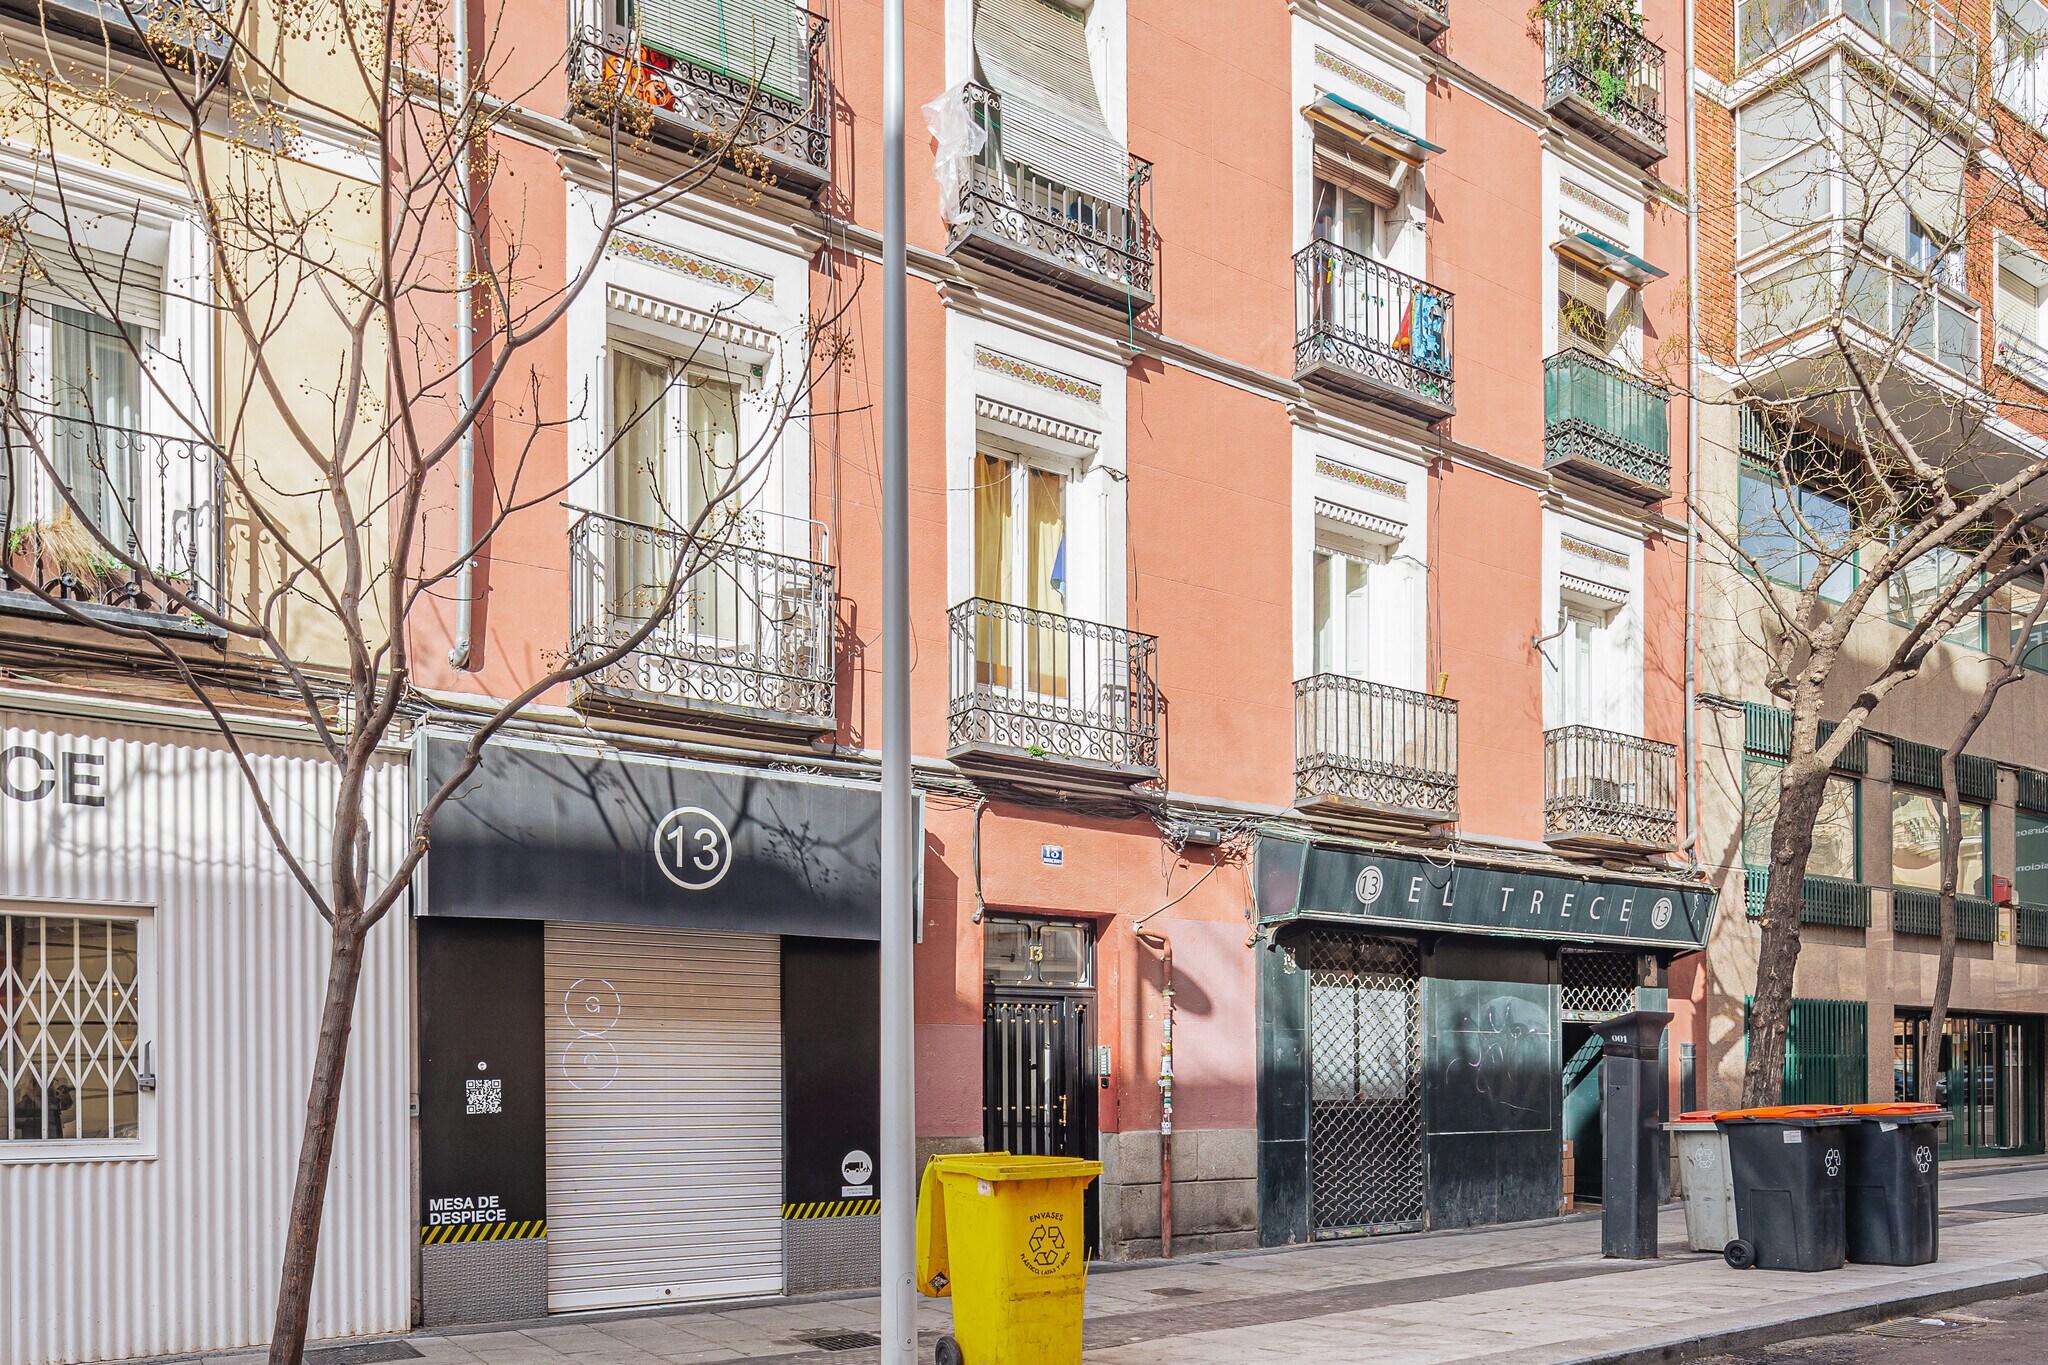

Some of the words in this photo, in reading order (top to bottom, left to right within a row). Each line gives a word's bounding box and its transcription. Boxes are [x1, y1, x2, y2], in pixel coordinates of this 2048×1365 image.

[0, 746, 105, 806] CE
[667, 825, 719, 871] 13
[1045, 847, 1060, 859] 13
[1361, 875, 1379, 896] 13
[1408, 876, 1453, 906] EL
[1501, 887, 1633, 922] TRECE
[1655, 905, 1669, 923] 13
[1029, 945, 1043, 961] 13
[1611, 1034, 1628, 1044] 001
[429, 1197, 474, 1211] MESA
[478, 1195, 499, 1209] DE
[430, 1209, 507, 1225] DESPIECE
[1029, 1212, 1064, 1222] ENVASES
